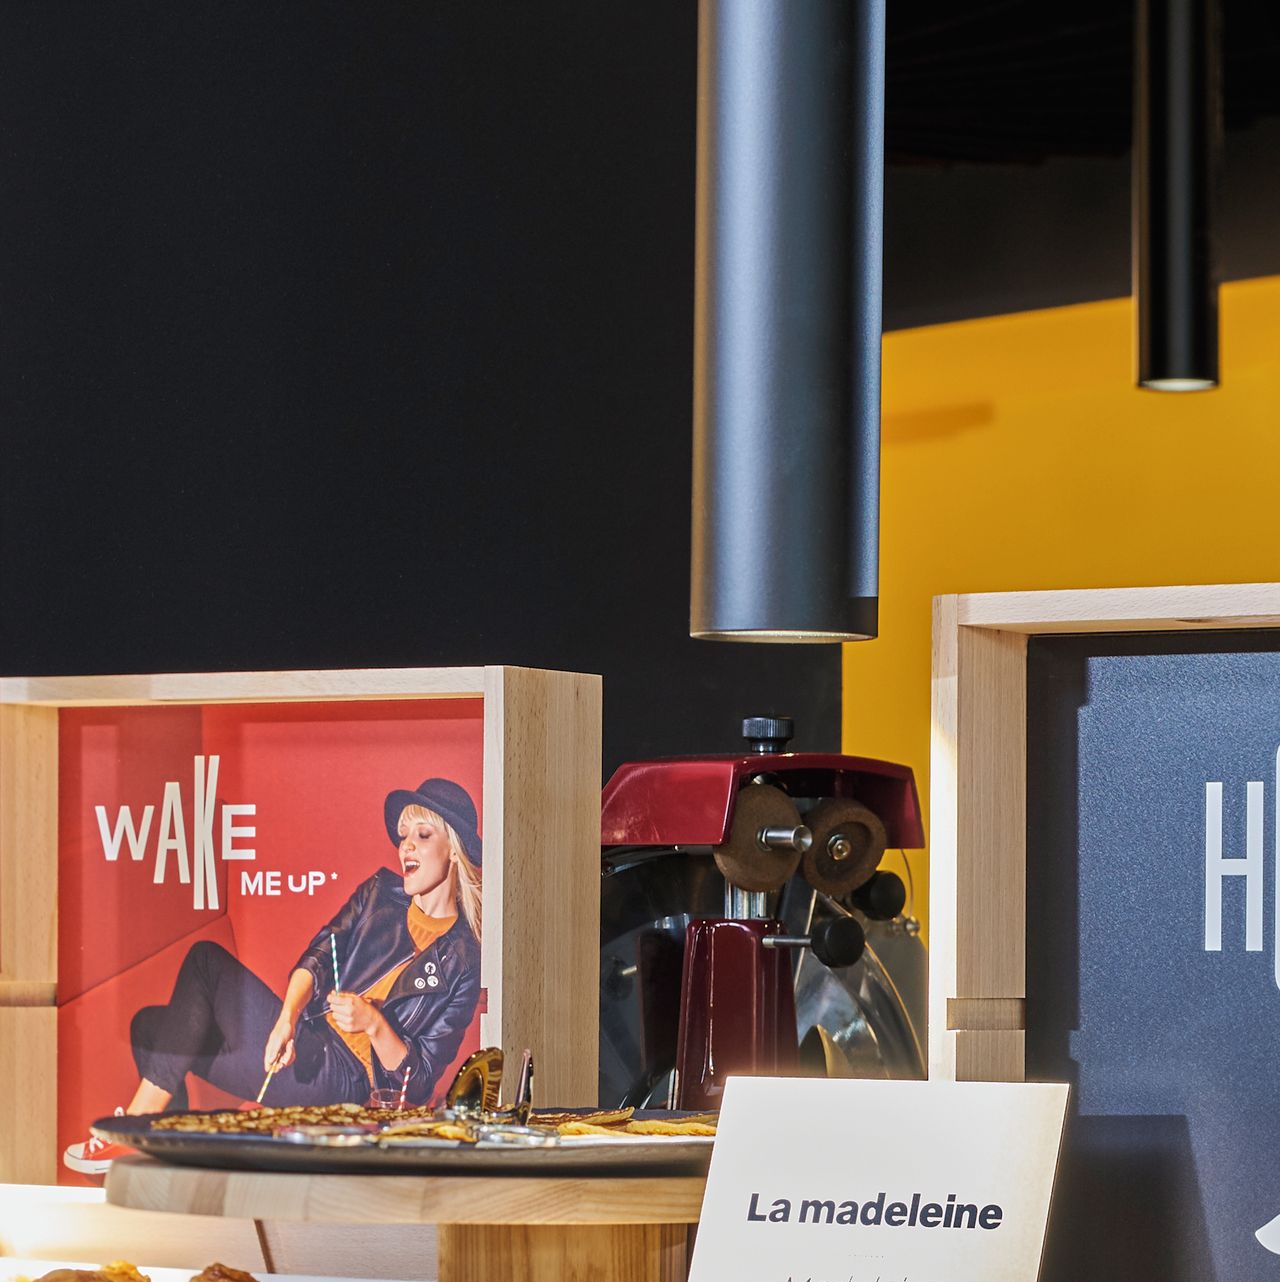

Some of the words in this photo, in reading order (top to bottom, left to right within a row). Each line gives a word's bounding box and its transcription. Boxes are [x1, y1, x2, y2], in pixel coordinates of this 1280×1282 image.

[95, 755, 256, 909] WAKE
[240, 871, 281, 896] ME
[747, 1193, 792, 1223] La
[799, 1193, 1003, 1230] madeleine
